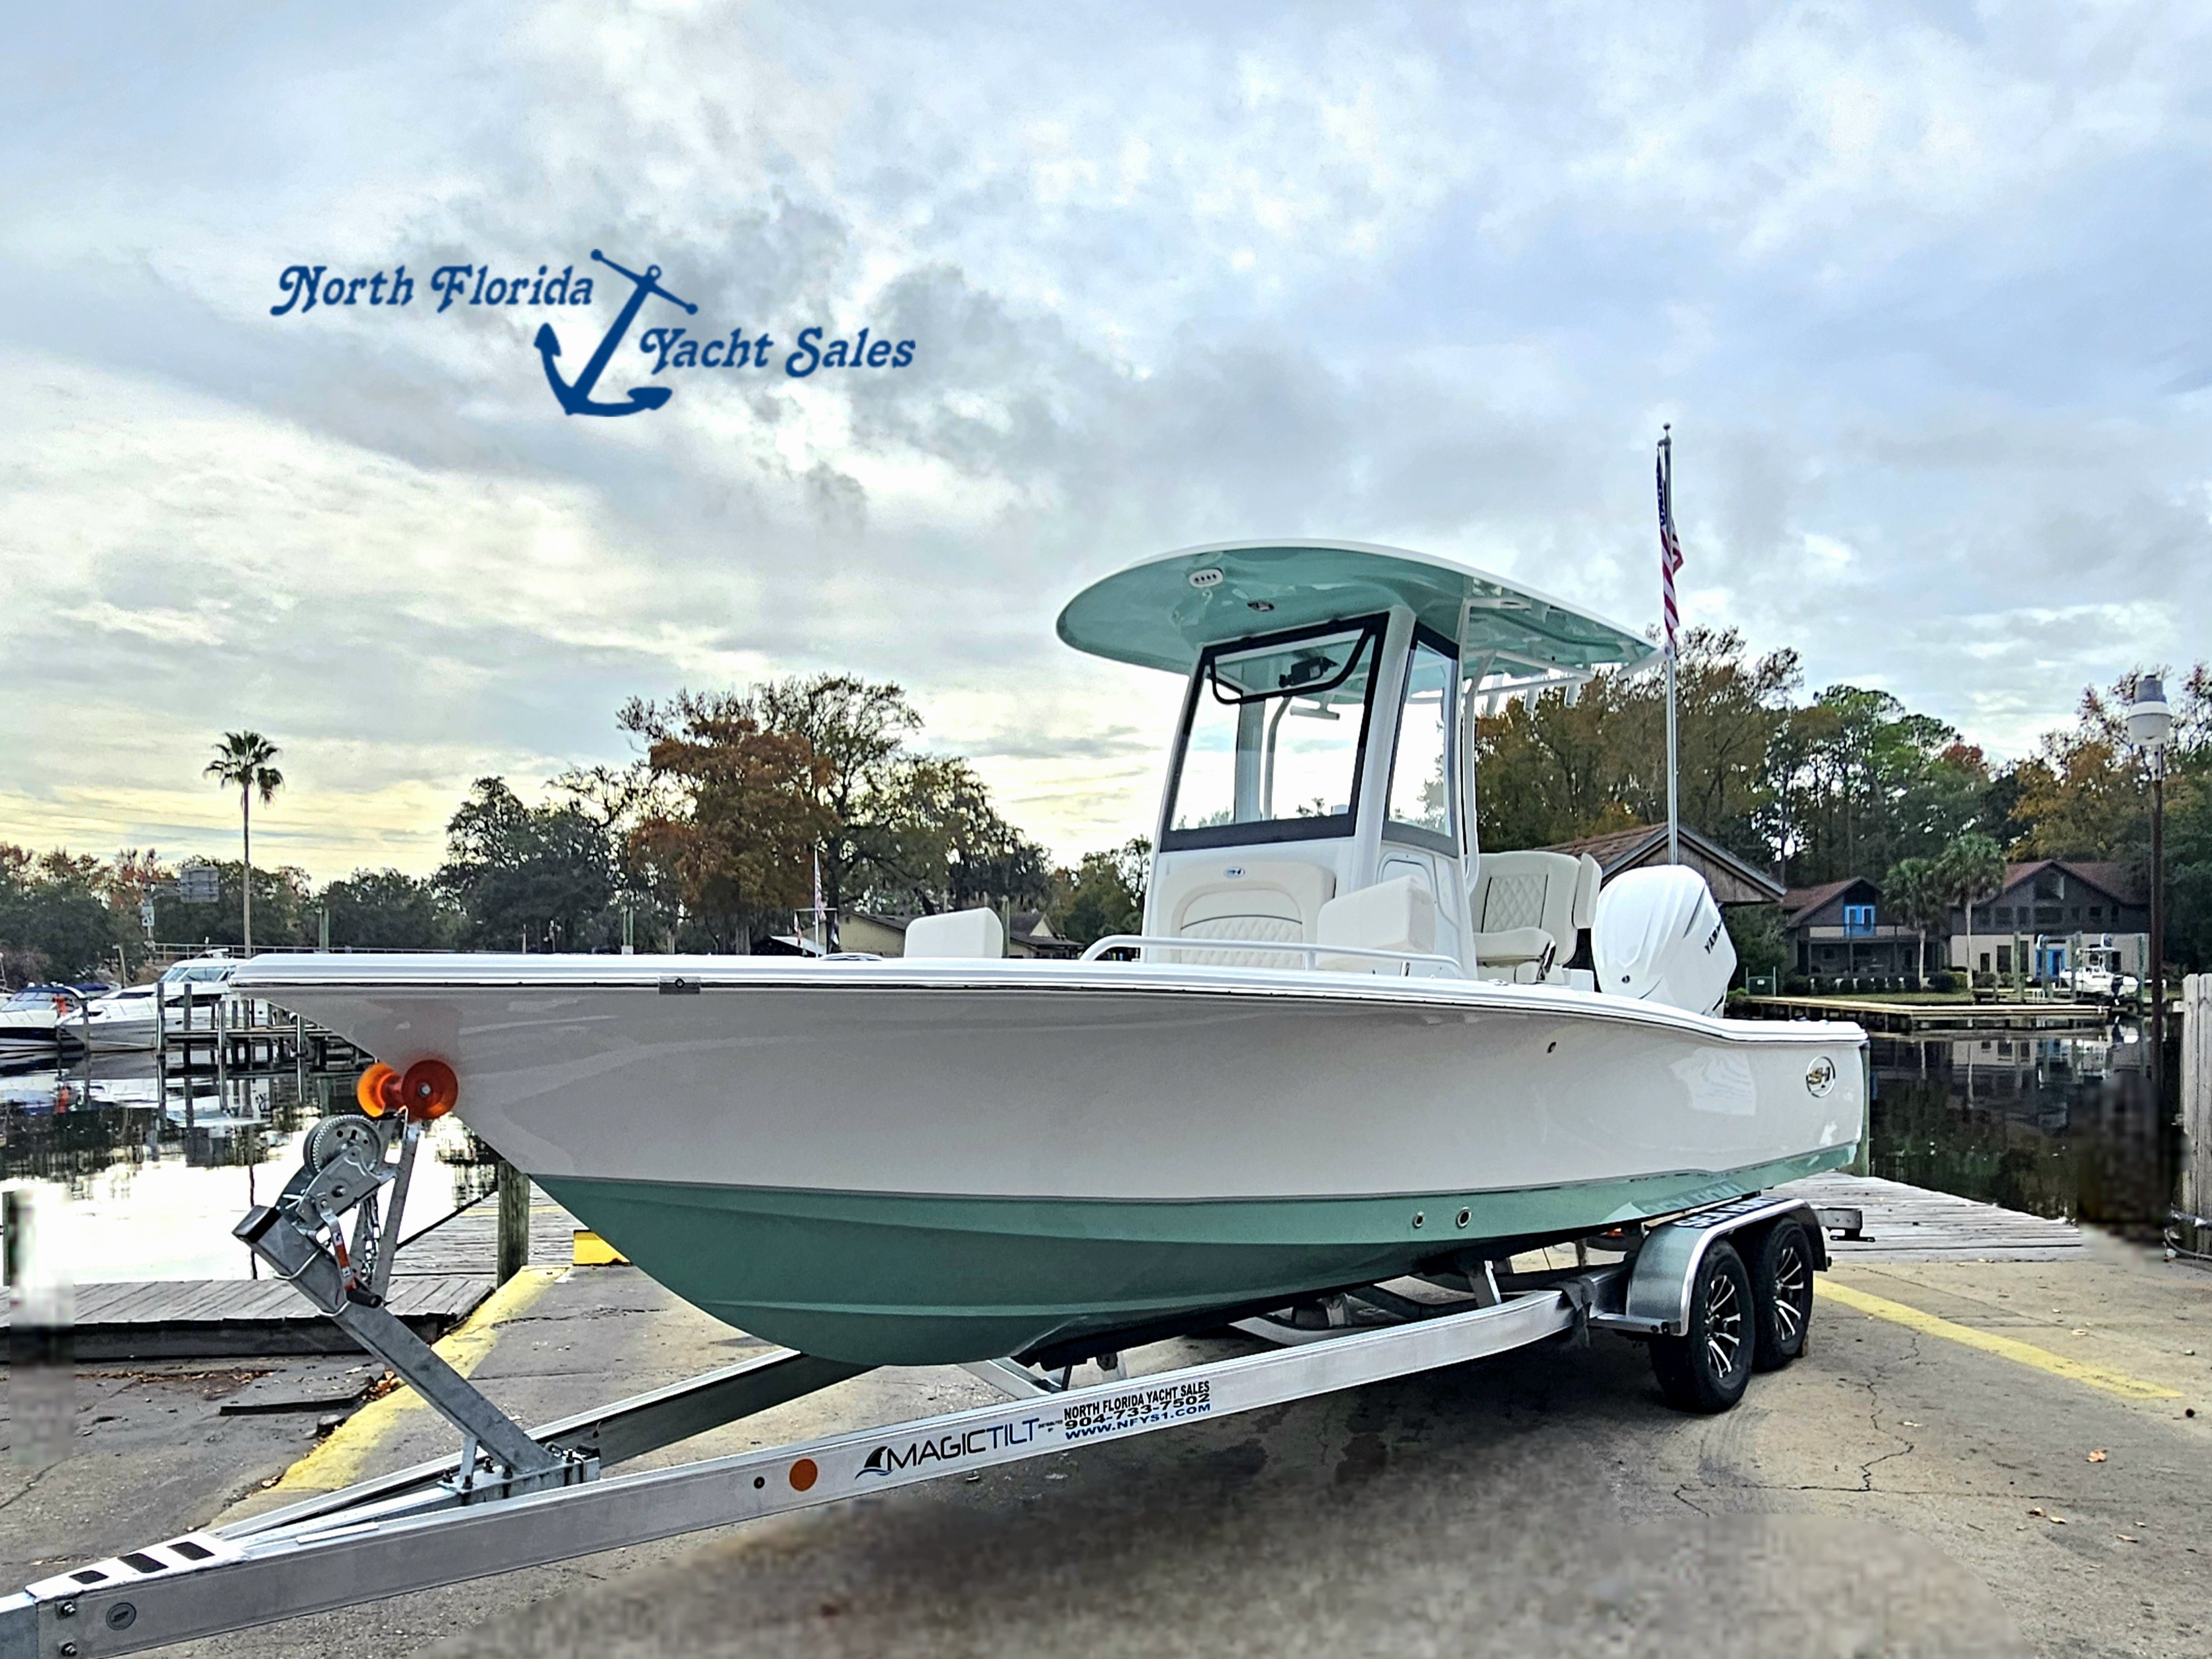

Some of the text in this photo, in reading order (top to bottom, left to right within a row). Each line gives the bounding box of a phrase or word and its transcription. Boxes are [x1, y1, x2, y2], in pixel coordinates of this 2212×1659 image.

[1064, 1380, 1210, 1421] NORTH FLORIDA YACHT SALES
[1065, 1393, 1210, 1430] 904-733-7502
[1065, 1403, 1210, 1440] WWW.NFYS1.COM
[887, 1417, 1040, 1472] MAGICTILT
